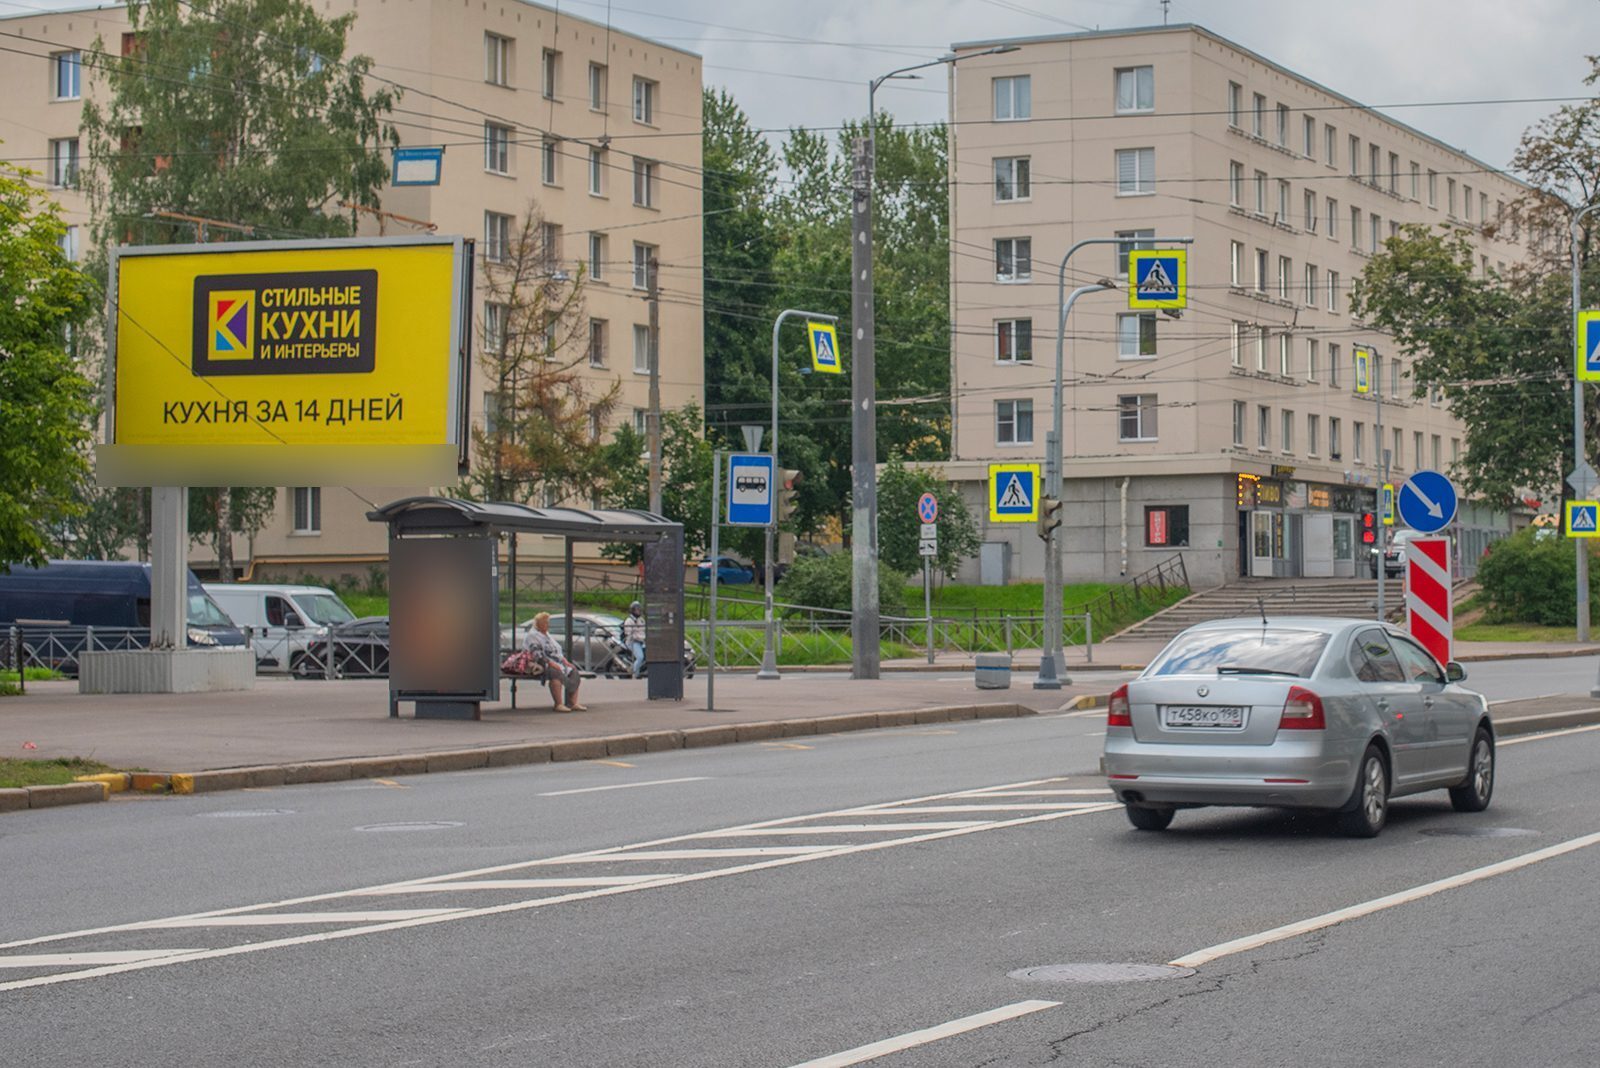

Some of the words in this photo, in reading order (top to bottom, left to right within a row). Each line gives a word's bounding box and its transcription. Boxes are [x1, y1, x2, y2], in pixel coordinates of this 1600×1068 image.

[261, 286, 362, 308] СТИЛЬНЫЕ
[260, 309, 361, 341] КУХНИ
[260, 344, 272, 360] И
[274, 342, 360, 360] ИНТЕРЬЕРЫ
[163, 400, 249, 424] КУХНЯ
[256, 400, 289, 422] ЗА
[294, 400, 320, 422] 14
[326, 392, 404, 426] ДНЕЙ
